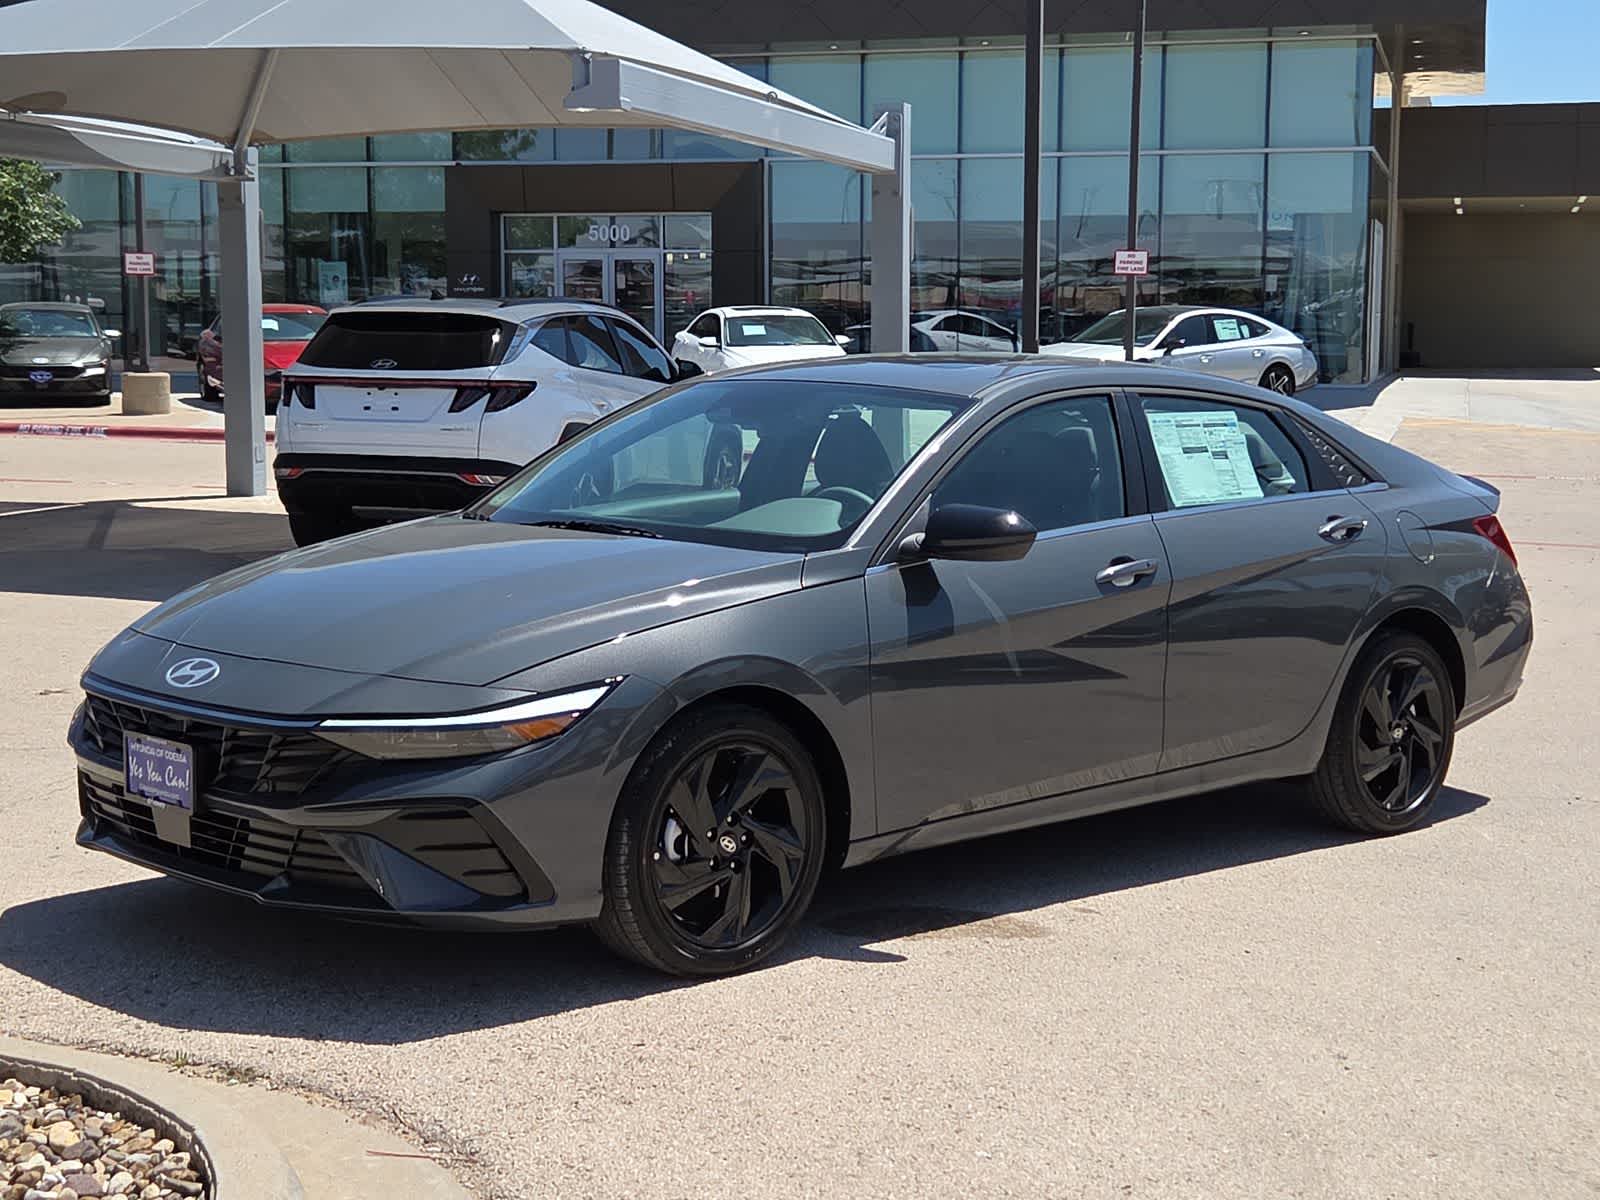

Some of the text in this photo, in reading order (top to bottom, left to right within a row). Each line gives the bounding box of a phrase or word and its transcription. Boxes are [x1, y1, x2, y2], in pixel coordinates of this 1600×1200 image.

[588, 224, 630, 241] 5000
[156, 748, 165, 758] OF
[129, 755, 190, 791] Yes You Can!
